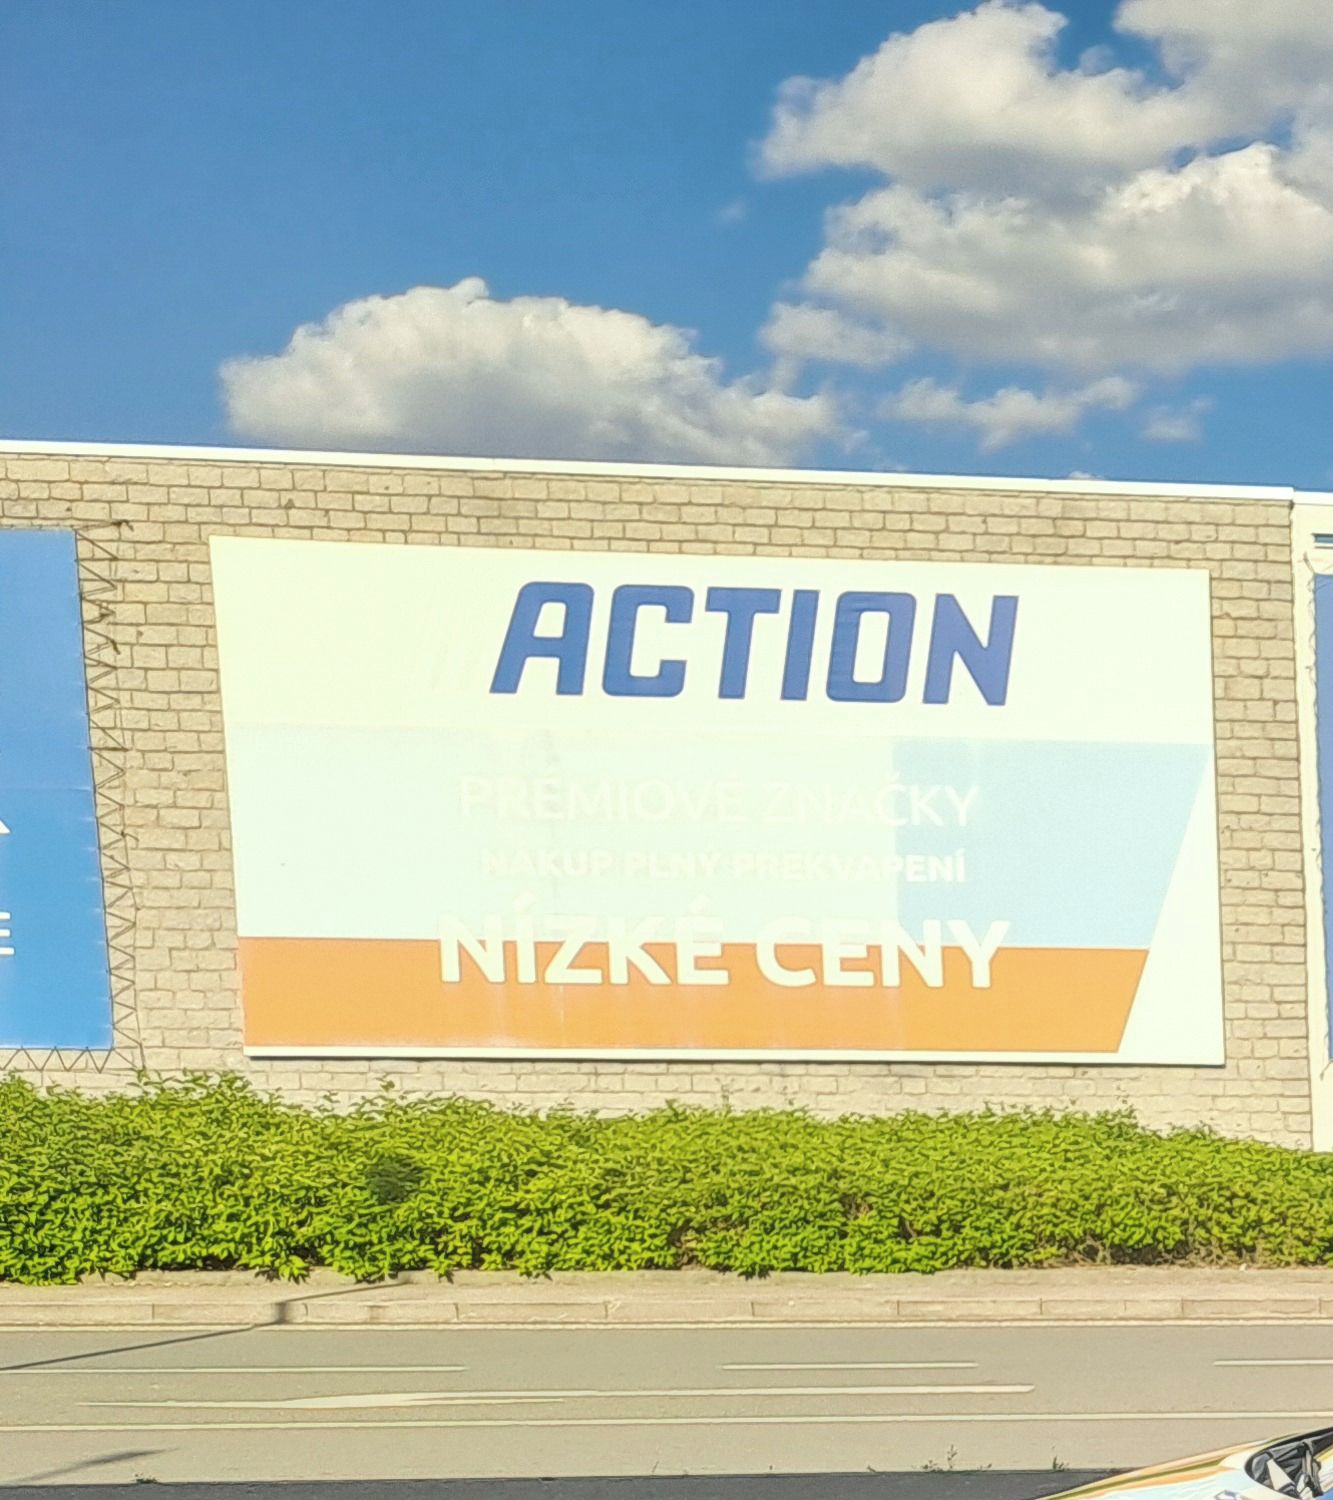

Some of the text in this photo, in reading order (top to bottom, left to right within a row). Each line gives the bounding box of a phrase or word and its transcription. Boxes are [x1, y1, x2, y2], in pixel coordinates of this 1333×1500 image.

[488, 580, 1019, 706] ACTION
[438, 889, 1012, 989] NÍZKÉ CENY
